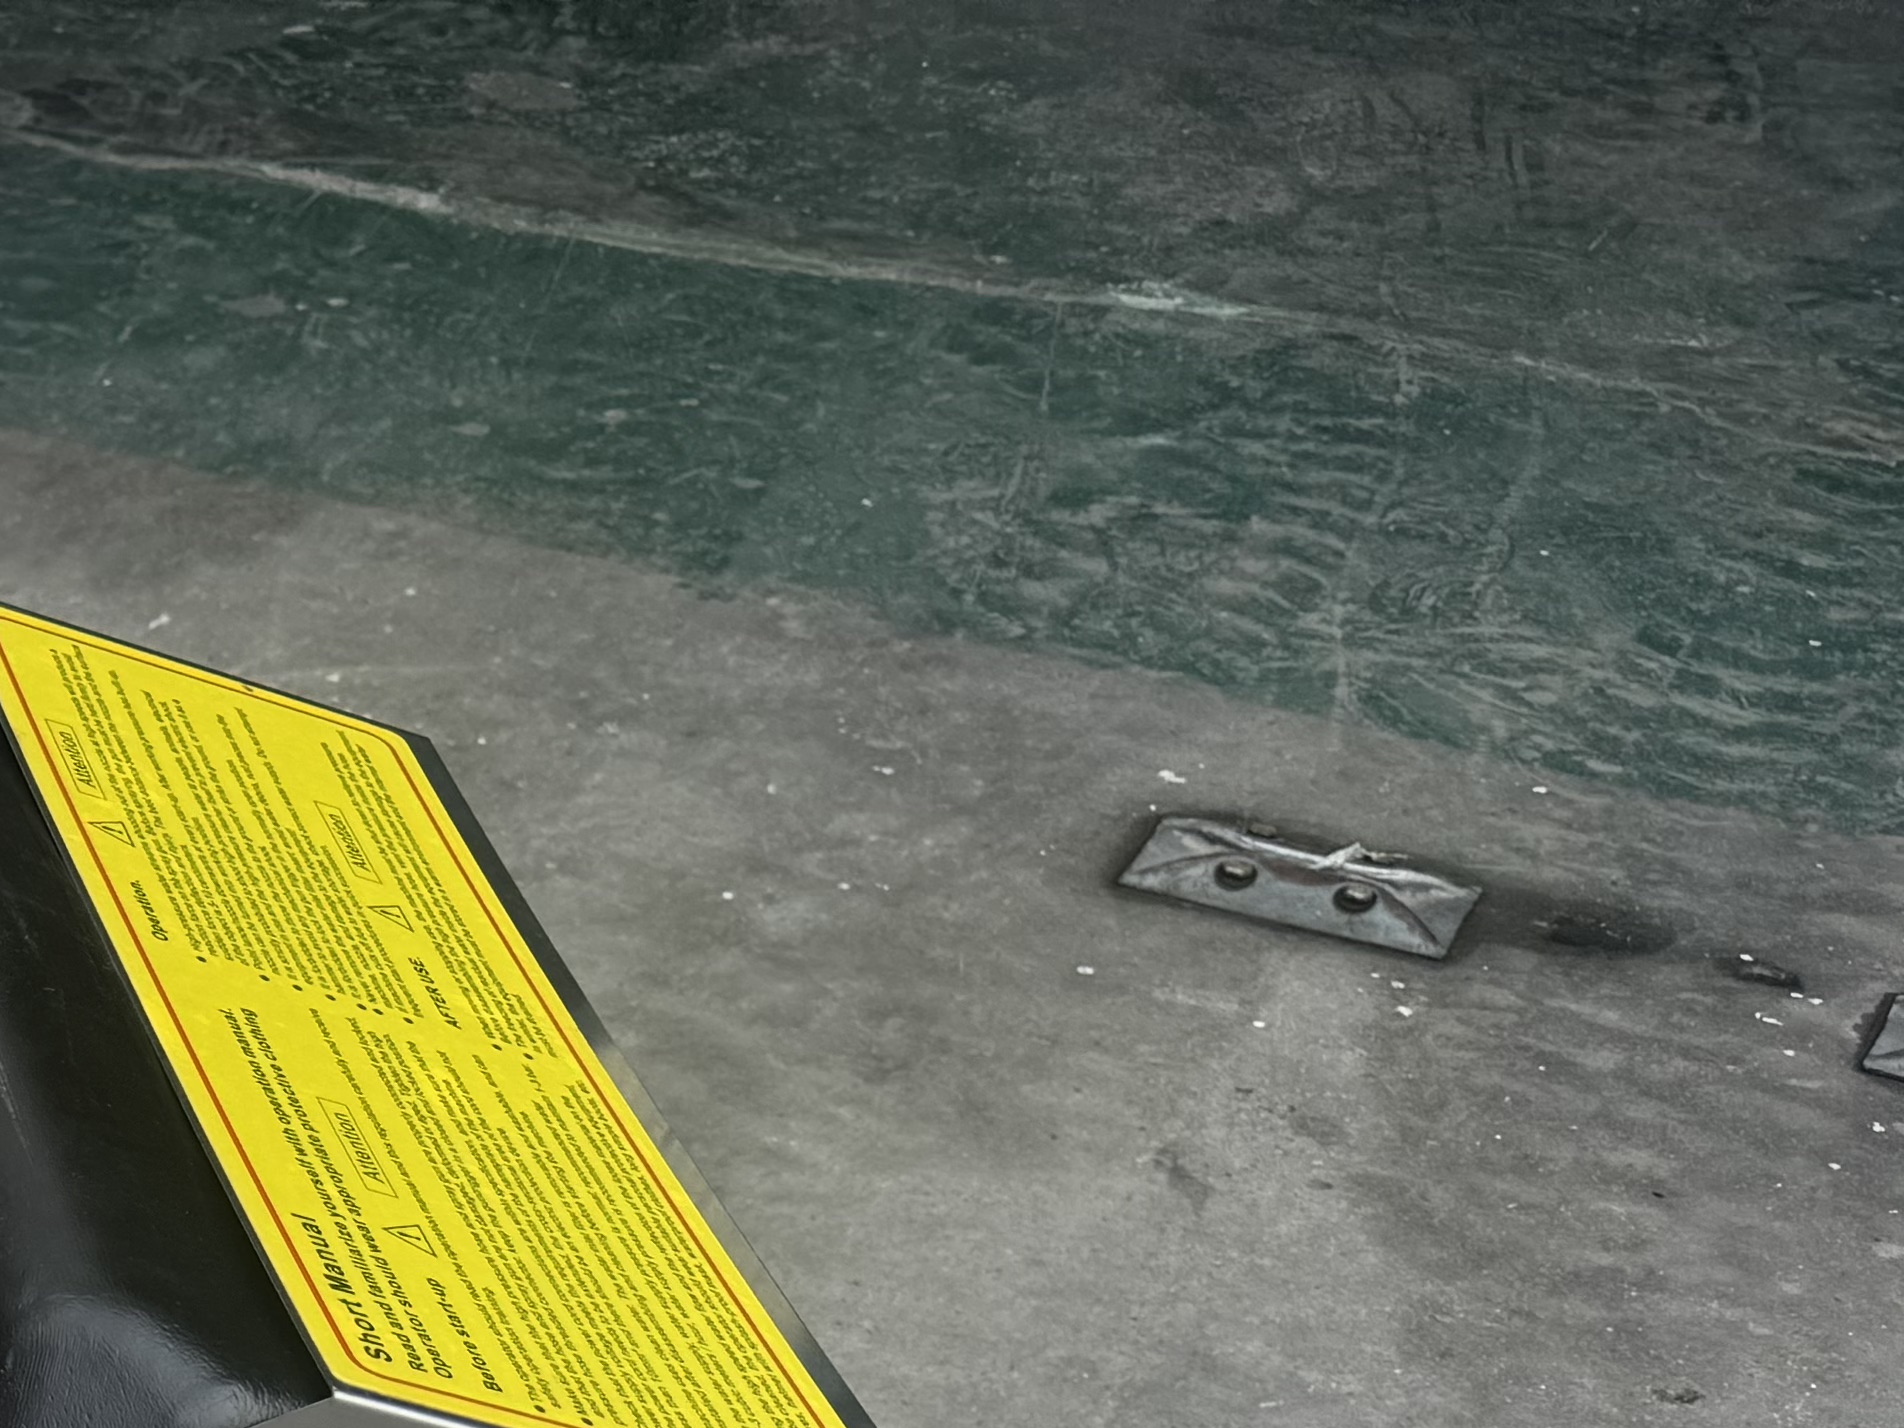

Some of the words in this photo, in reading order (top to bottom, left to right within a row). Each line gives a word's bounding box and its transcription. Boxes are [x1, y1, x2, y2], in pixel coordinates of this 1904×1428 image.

[57, 729, 97, 790] Attention
[326, 812, 372, 873] Attention
[128, 878, 169, 942] Operation.
[406, 955, 435, 985] USE.
[216, 1007, 257, 1059] manual.
[238, 1006, 278, 1062] clothing
[423, 984, 463, 1030] AFTER
[246, 1058, 292, 1126] operation
[268, 1062, 320, 1134] protective
[280, 1126, 309, 1157] with
[332, 1111, 386, 1185] Attention
[293, 1155, 347, 1221] yourself
[305, 1133, 362, 1218] appropriate
[289, 1211, 356, 1296] Manual
[332, 1220, 387, 1300] familiarize
[350, 1216, 382, 1254] wear
[367, 1253, 413, 1309] should
[424, 1276, 471, 1339] start-up
[336, 1297, 393, 1363] Short
[371, 1298, 405, 1331] and
[402, 1308, 454, 1380] Operator
[389, 1330, 429, 1374] Read
[461, 1339, 504, 1393] Before
